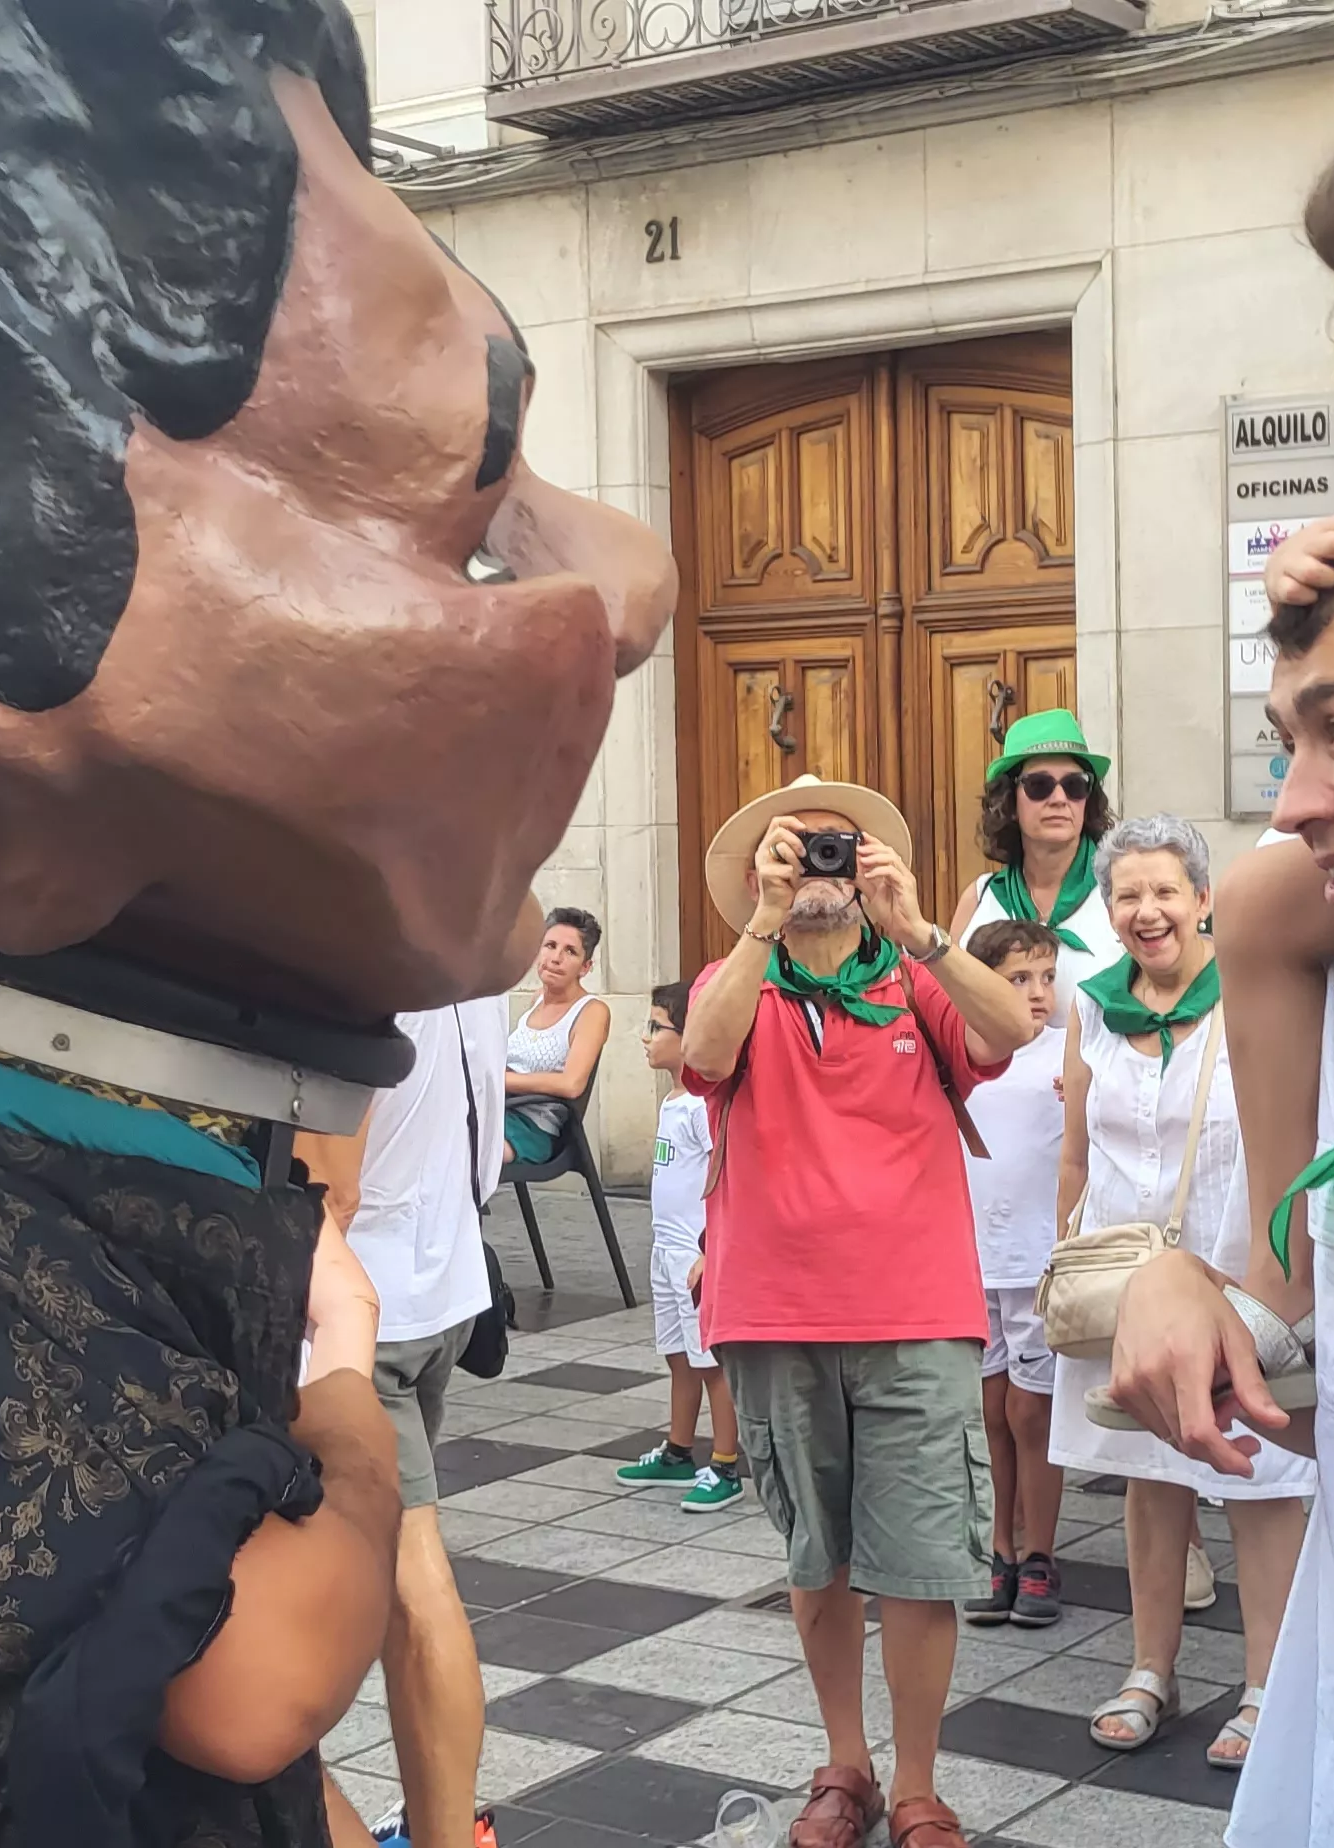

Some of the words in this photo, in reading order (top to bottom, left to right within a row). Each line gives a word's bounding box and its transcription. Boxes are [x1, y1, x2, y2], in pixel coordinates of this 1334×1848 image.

[645, 216, 681, 263] 21
[1235, 411, 1327, 448] ALQUILO
[1236, 476, 1329, 499] OFICINAS
